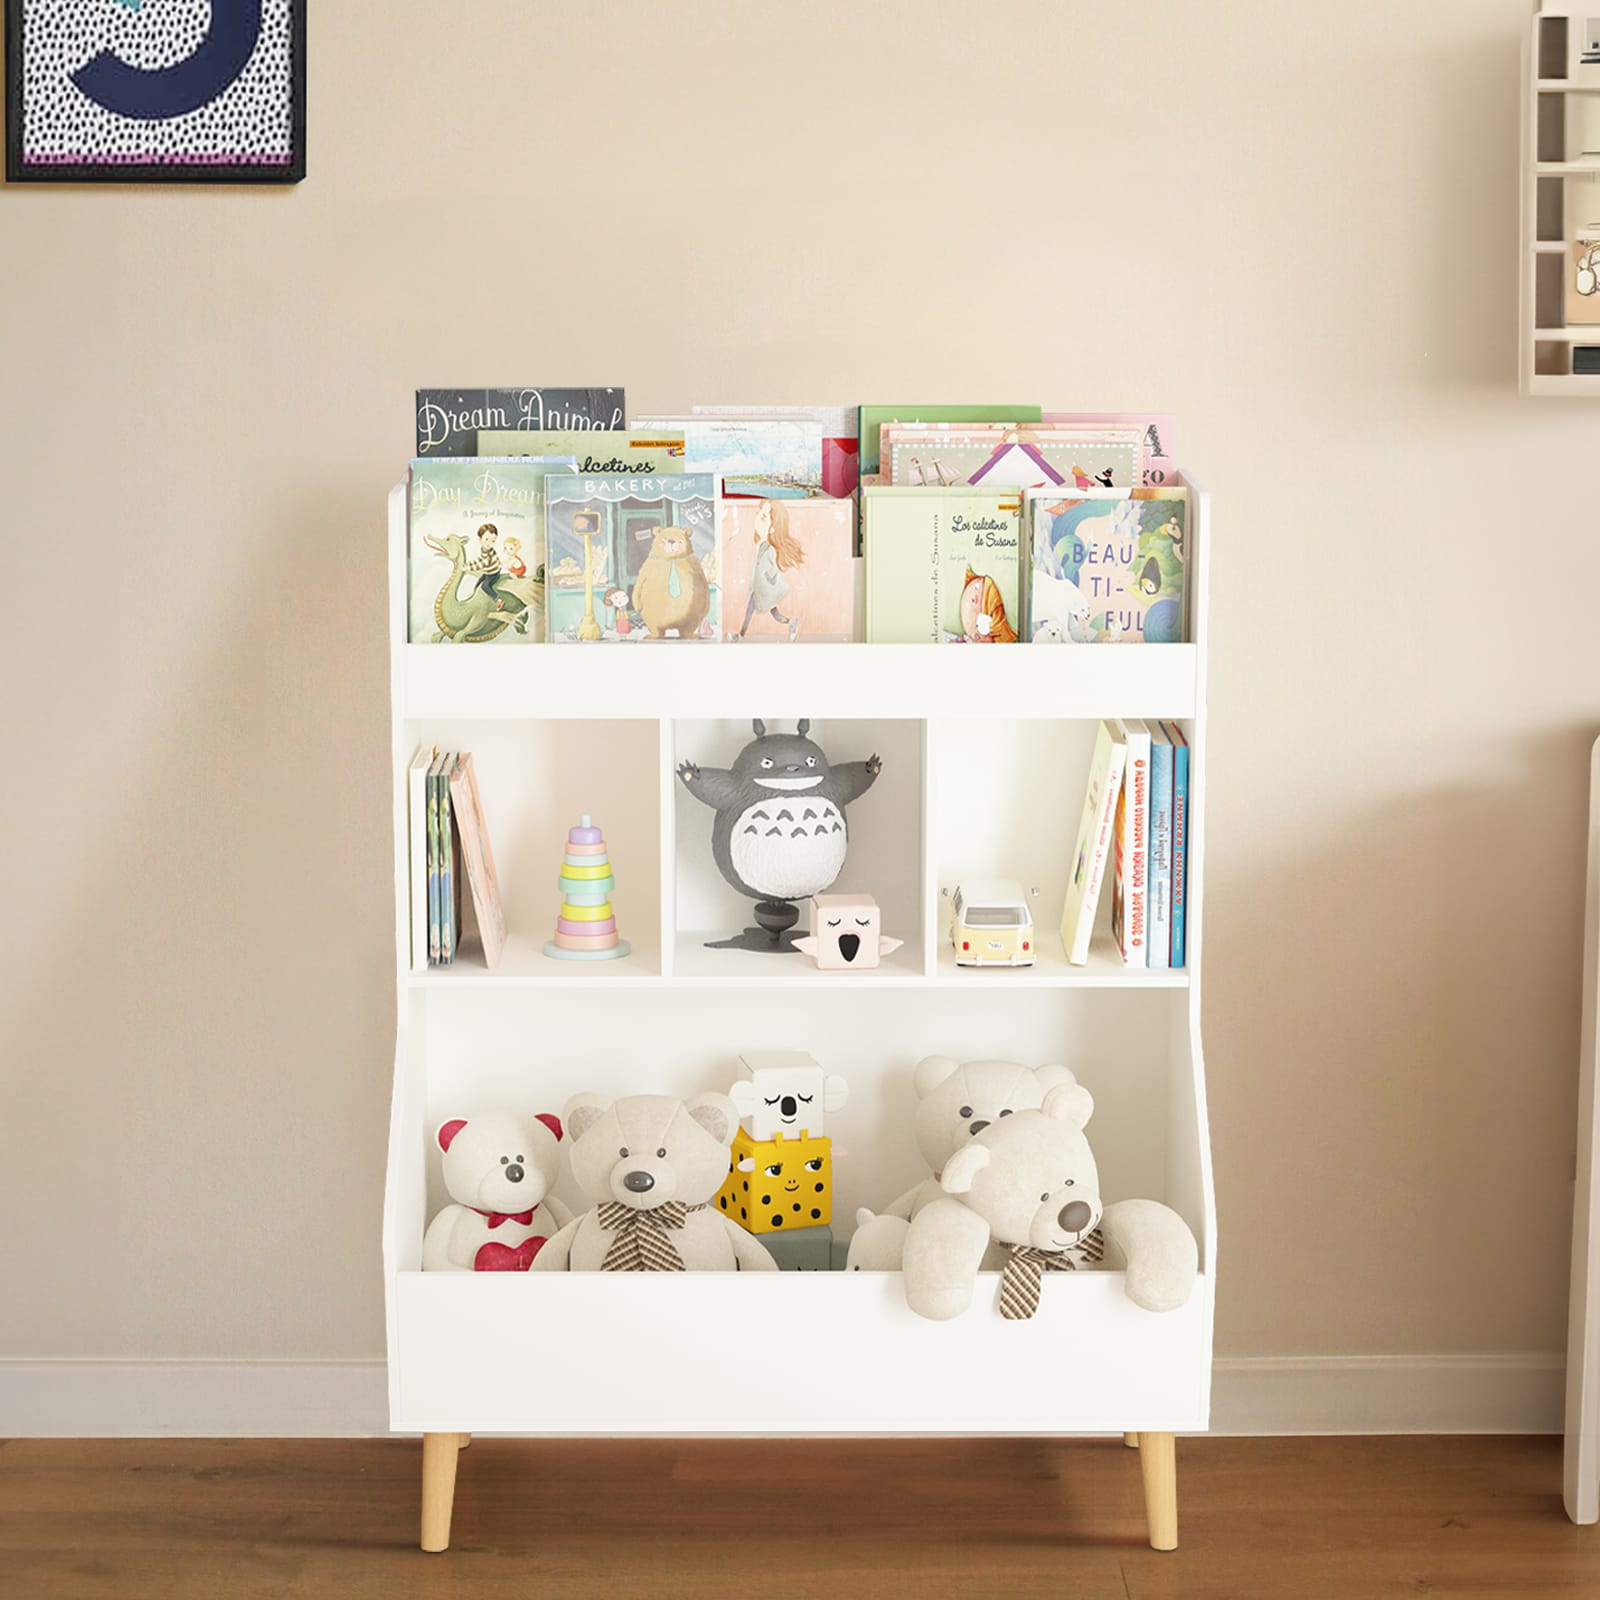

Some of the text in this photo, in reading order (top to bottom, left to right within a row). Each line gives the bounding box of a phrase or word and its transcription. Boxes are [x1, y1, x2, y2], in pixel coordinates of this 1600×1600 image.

[418, 398, 511, 454] Dream
[579, 456, 656, 474] lcetines
[412, 476, 462, 511] Day
[584, 478, 668, 493] BAKERY
[951, 514, 1008, 533] Los calcetines
[974, 531, 1018, 548] de Susana
[1072, 542, 1146, 565] BEAU-
[1089, 576, 1125, 598] TI-
[1104, 610, 1145, 633] FUL
